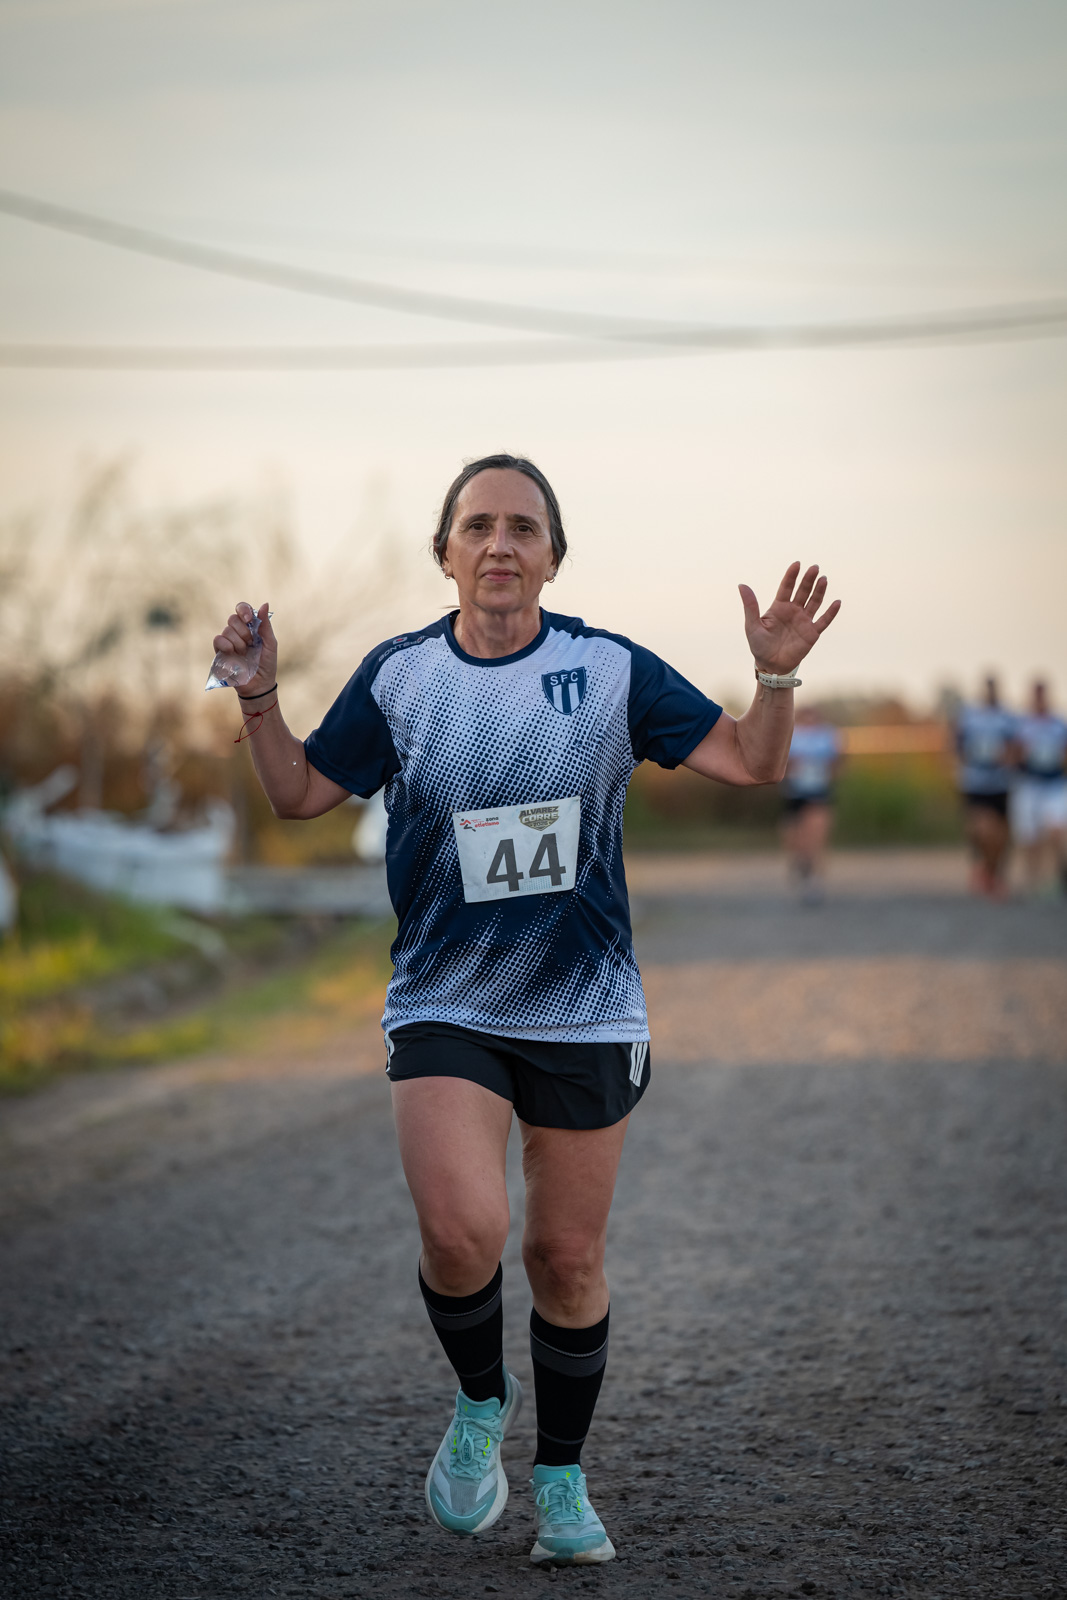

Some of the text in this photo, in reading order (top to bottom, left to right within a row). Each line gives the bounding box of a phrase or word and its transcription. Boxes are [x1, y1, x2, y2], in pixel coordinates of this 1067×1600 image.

[550, 671, 579, 686] SFC
[519, 806, 559, 817] ALVAREZ
[521, 812, 558, 823] CORRE
[486, 833, 567, 892] 44
